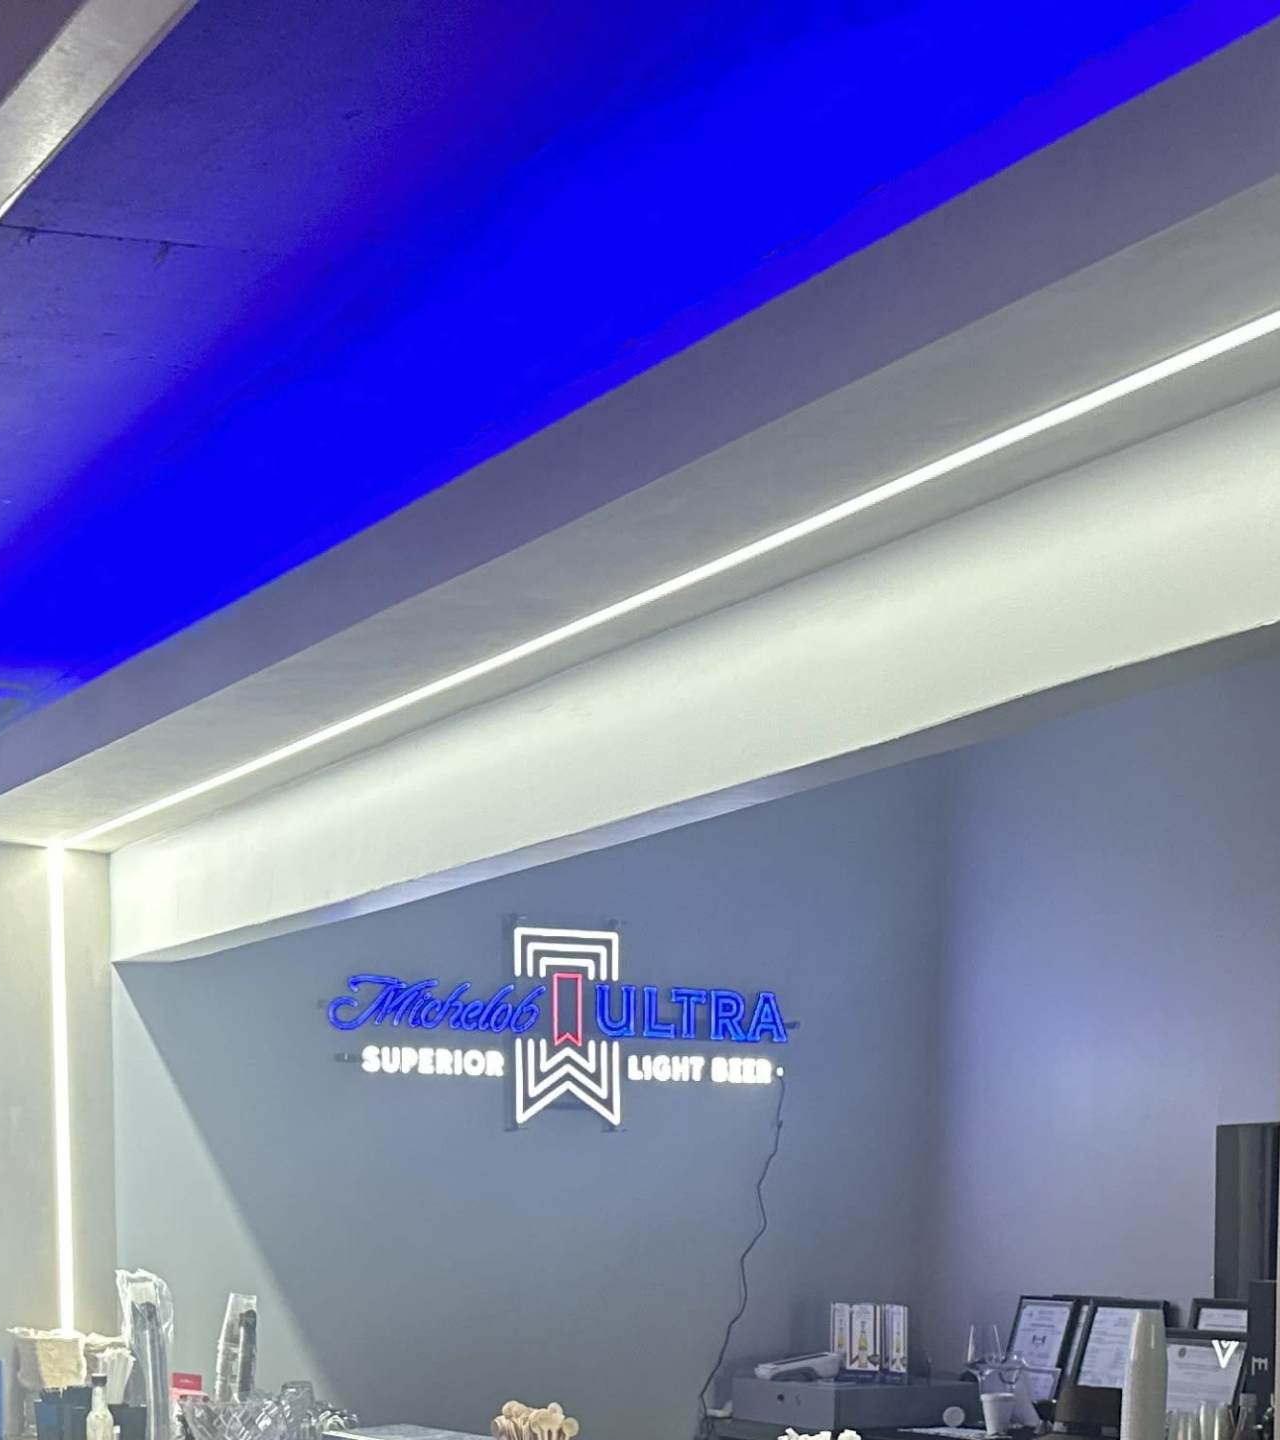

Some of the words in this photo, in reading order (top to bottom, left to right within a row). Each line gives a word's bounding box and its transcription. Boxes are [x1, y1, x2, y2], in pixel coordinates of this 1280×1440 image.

[328, 974, 546, 1033] Michelob
[595, 982, 788, 1043] ULTRA
[361, 1045, 505, 1077] SUPERIOR
[627, 1054, 705, 1082] LIGHT
[710, 1056, 773, 1084] BEER
